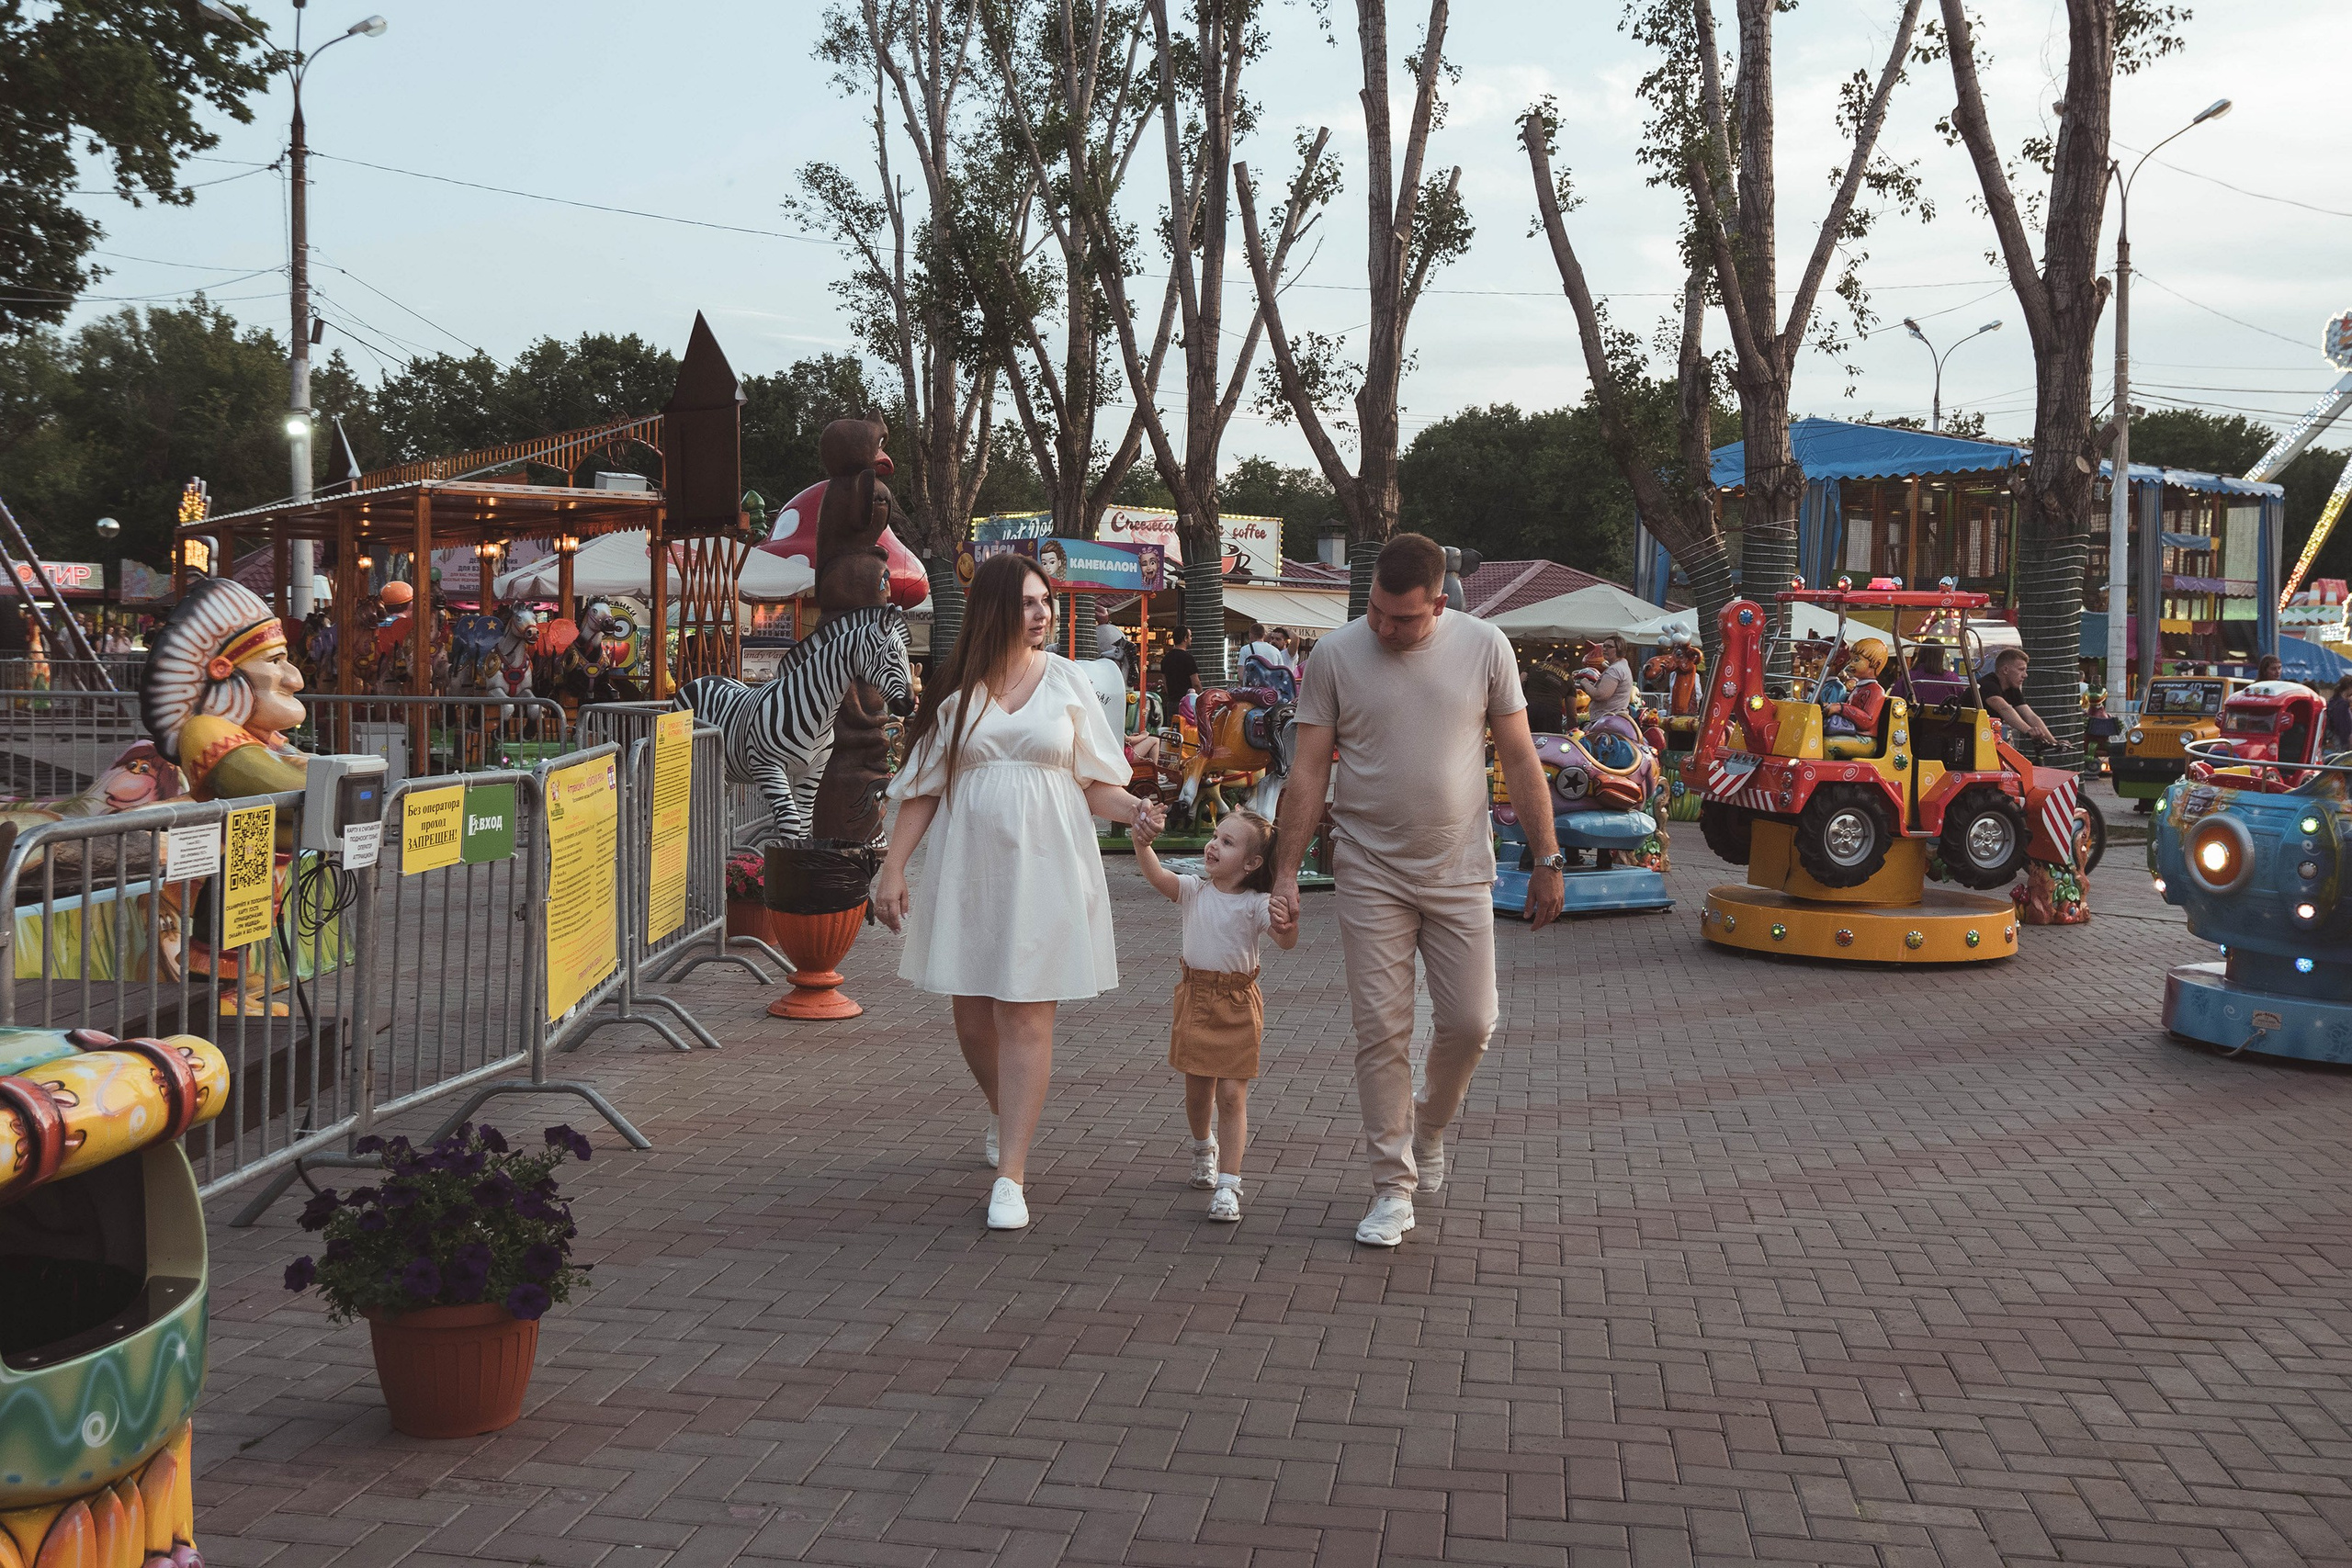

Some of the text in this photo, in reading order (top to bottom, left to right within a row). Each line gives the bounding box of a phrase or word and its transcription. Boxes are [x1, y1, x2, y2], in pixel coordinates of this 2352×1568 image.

[1232, 523, 1267, 540] coffee
[1069, 558, 1138, 573] КАНЕКАЛОН
[40, 564, 91, 586] ТИР
[743, 650, 765, 661] andy
[407, 799, 460, 817] Без оператора
[421, 818, 447, 833] проход
[479, 815, 503, 831] ВХОД
[407, 829, 458, 851] ЗАПРЕЩЕН!
